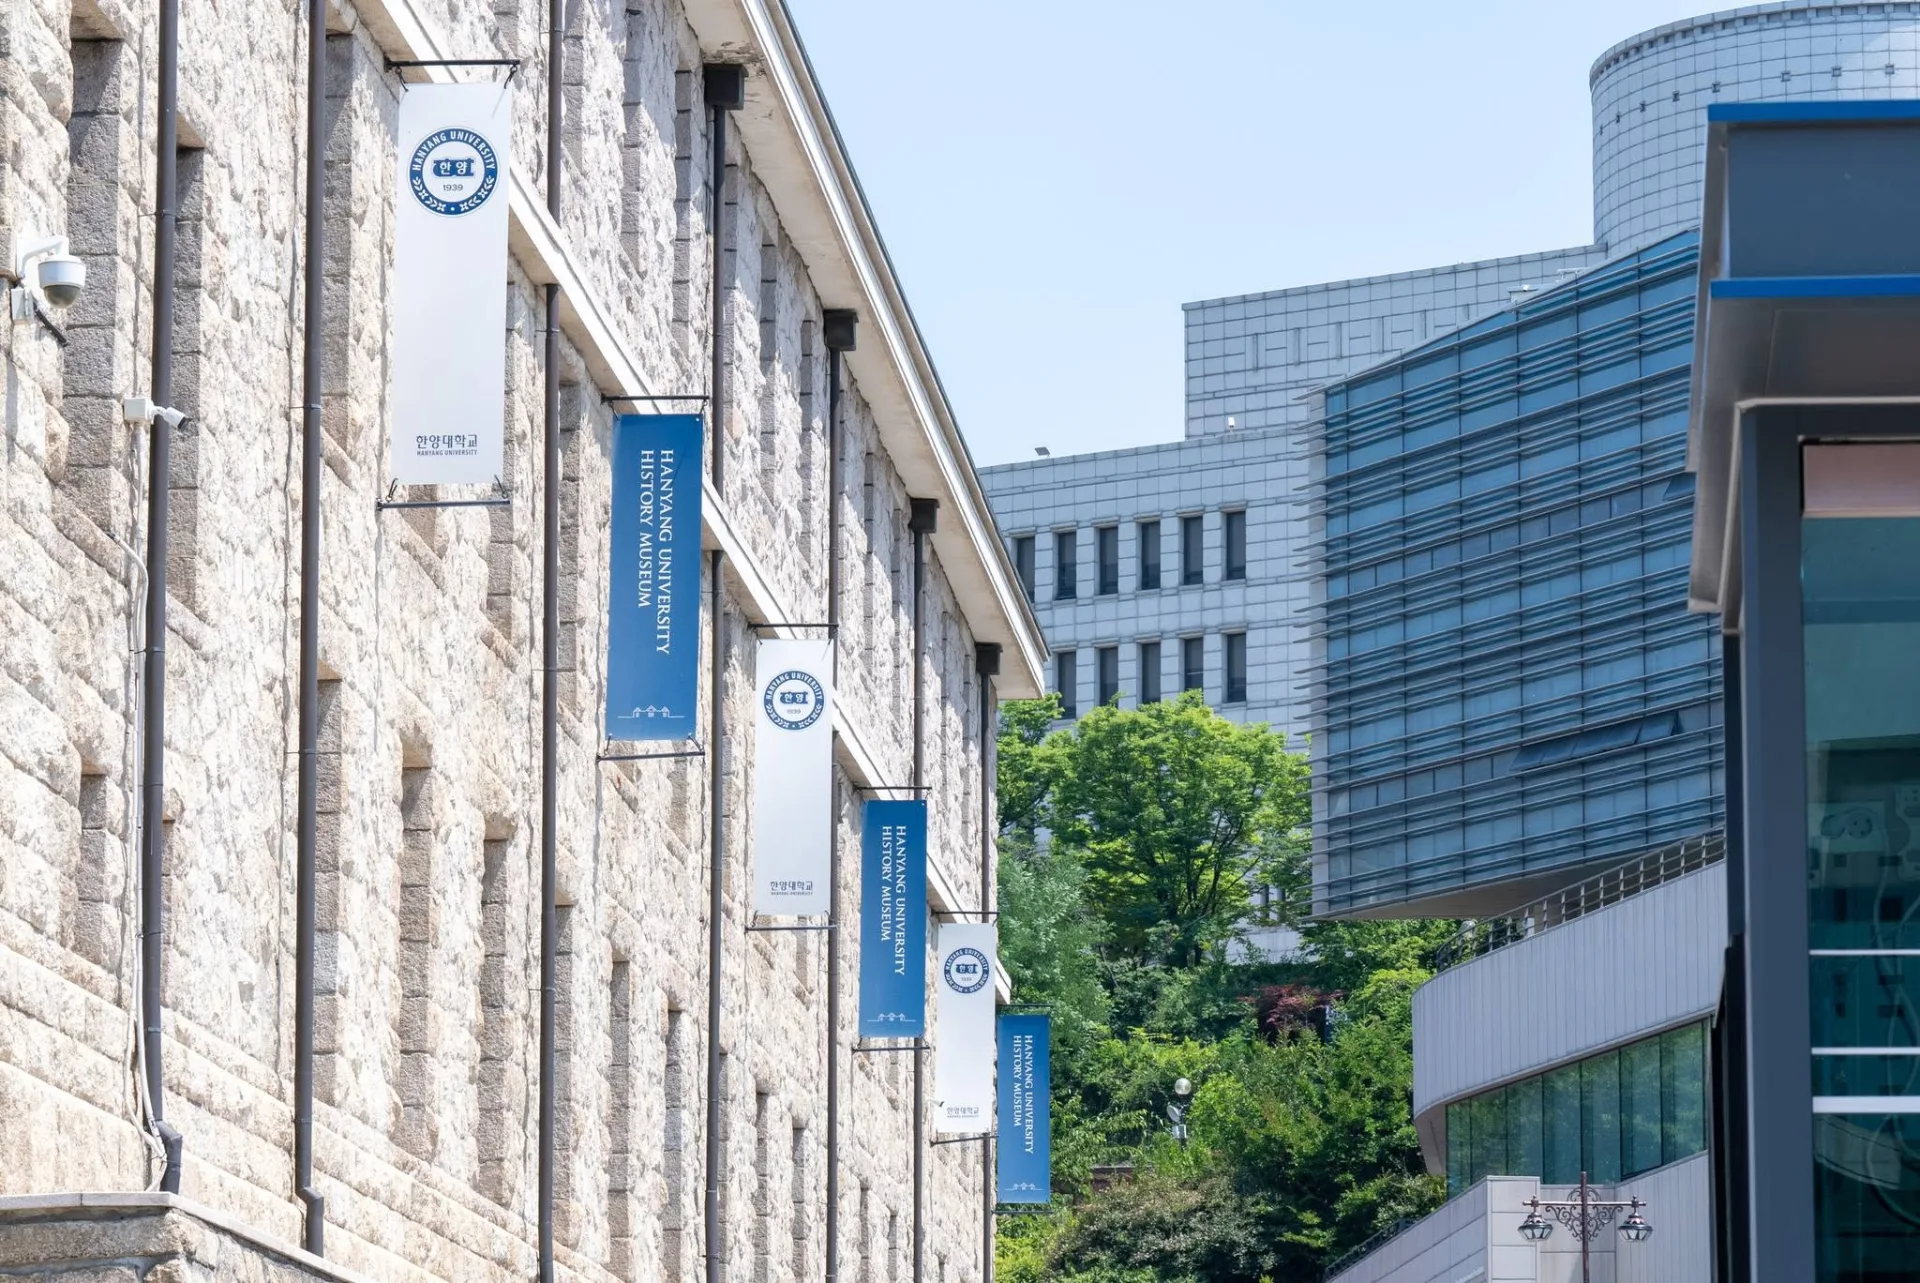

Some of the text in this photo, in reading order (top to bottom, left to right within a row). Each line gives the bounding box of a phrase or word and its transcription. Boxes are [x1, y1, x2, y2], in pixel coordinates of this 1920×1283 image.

[411, 130, 496, 171] HANYANG UNIVERSITY
[442, 184, 464, 192] 1939
[416, 434, 478, 449] 한양대학교
[638, 449, 655, 608] HISTORY MUSEUM
[656, 449, 674, 655] HANYANG UNIVERSITY
[791, 671, 823, 700] UNIVERSITY
[881, 825, 892, 941] HISTORY MUSEUM
[894, 825, 906, 976] HANYANG UNIVERSITY
[1013, 1035, 1022, 1127] HISTORY MUSEUM
[1024, 1035, 1034, 1154] HANYANG UNIVERSITY
